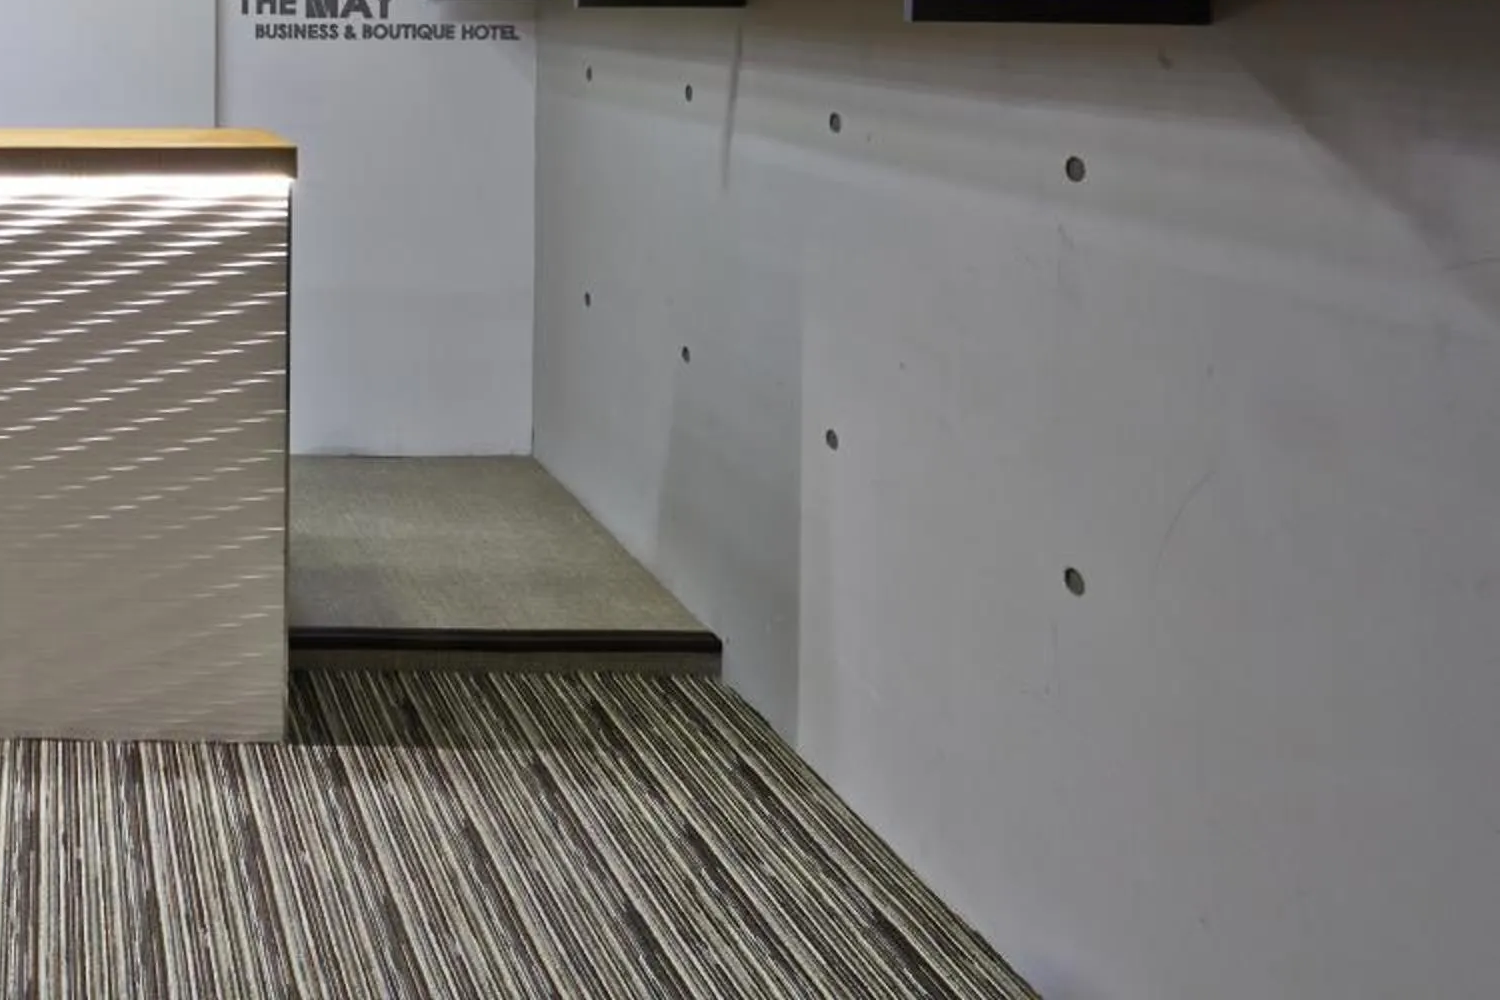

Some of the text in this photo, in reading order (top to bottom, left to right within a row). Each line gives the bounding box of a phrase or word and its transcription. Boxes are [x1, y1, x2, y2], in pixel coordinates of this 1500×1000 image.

[255, 23, 520, 41] BUSINESS & BOUTIQUE HOTEL
